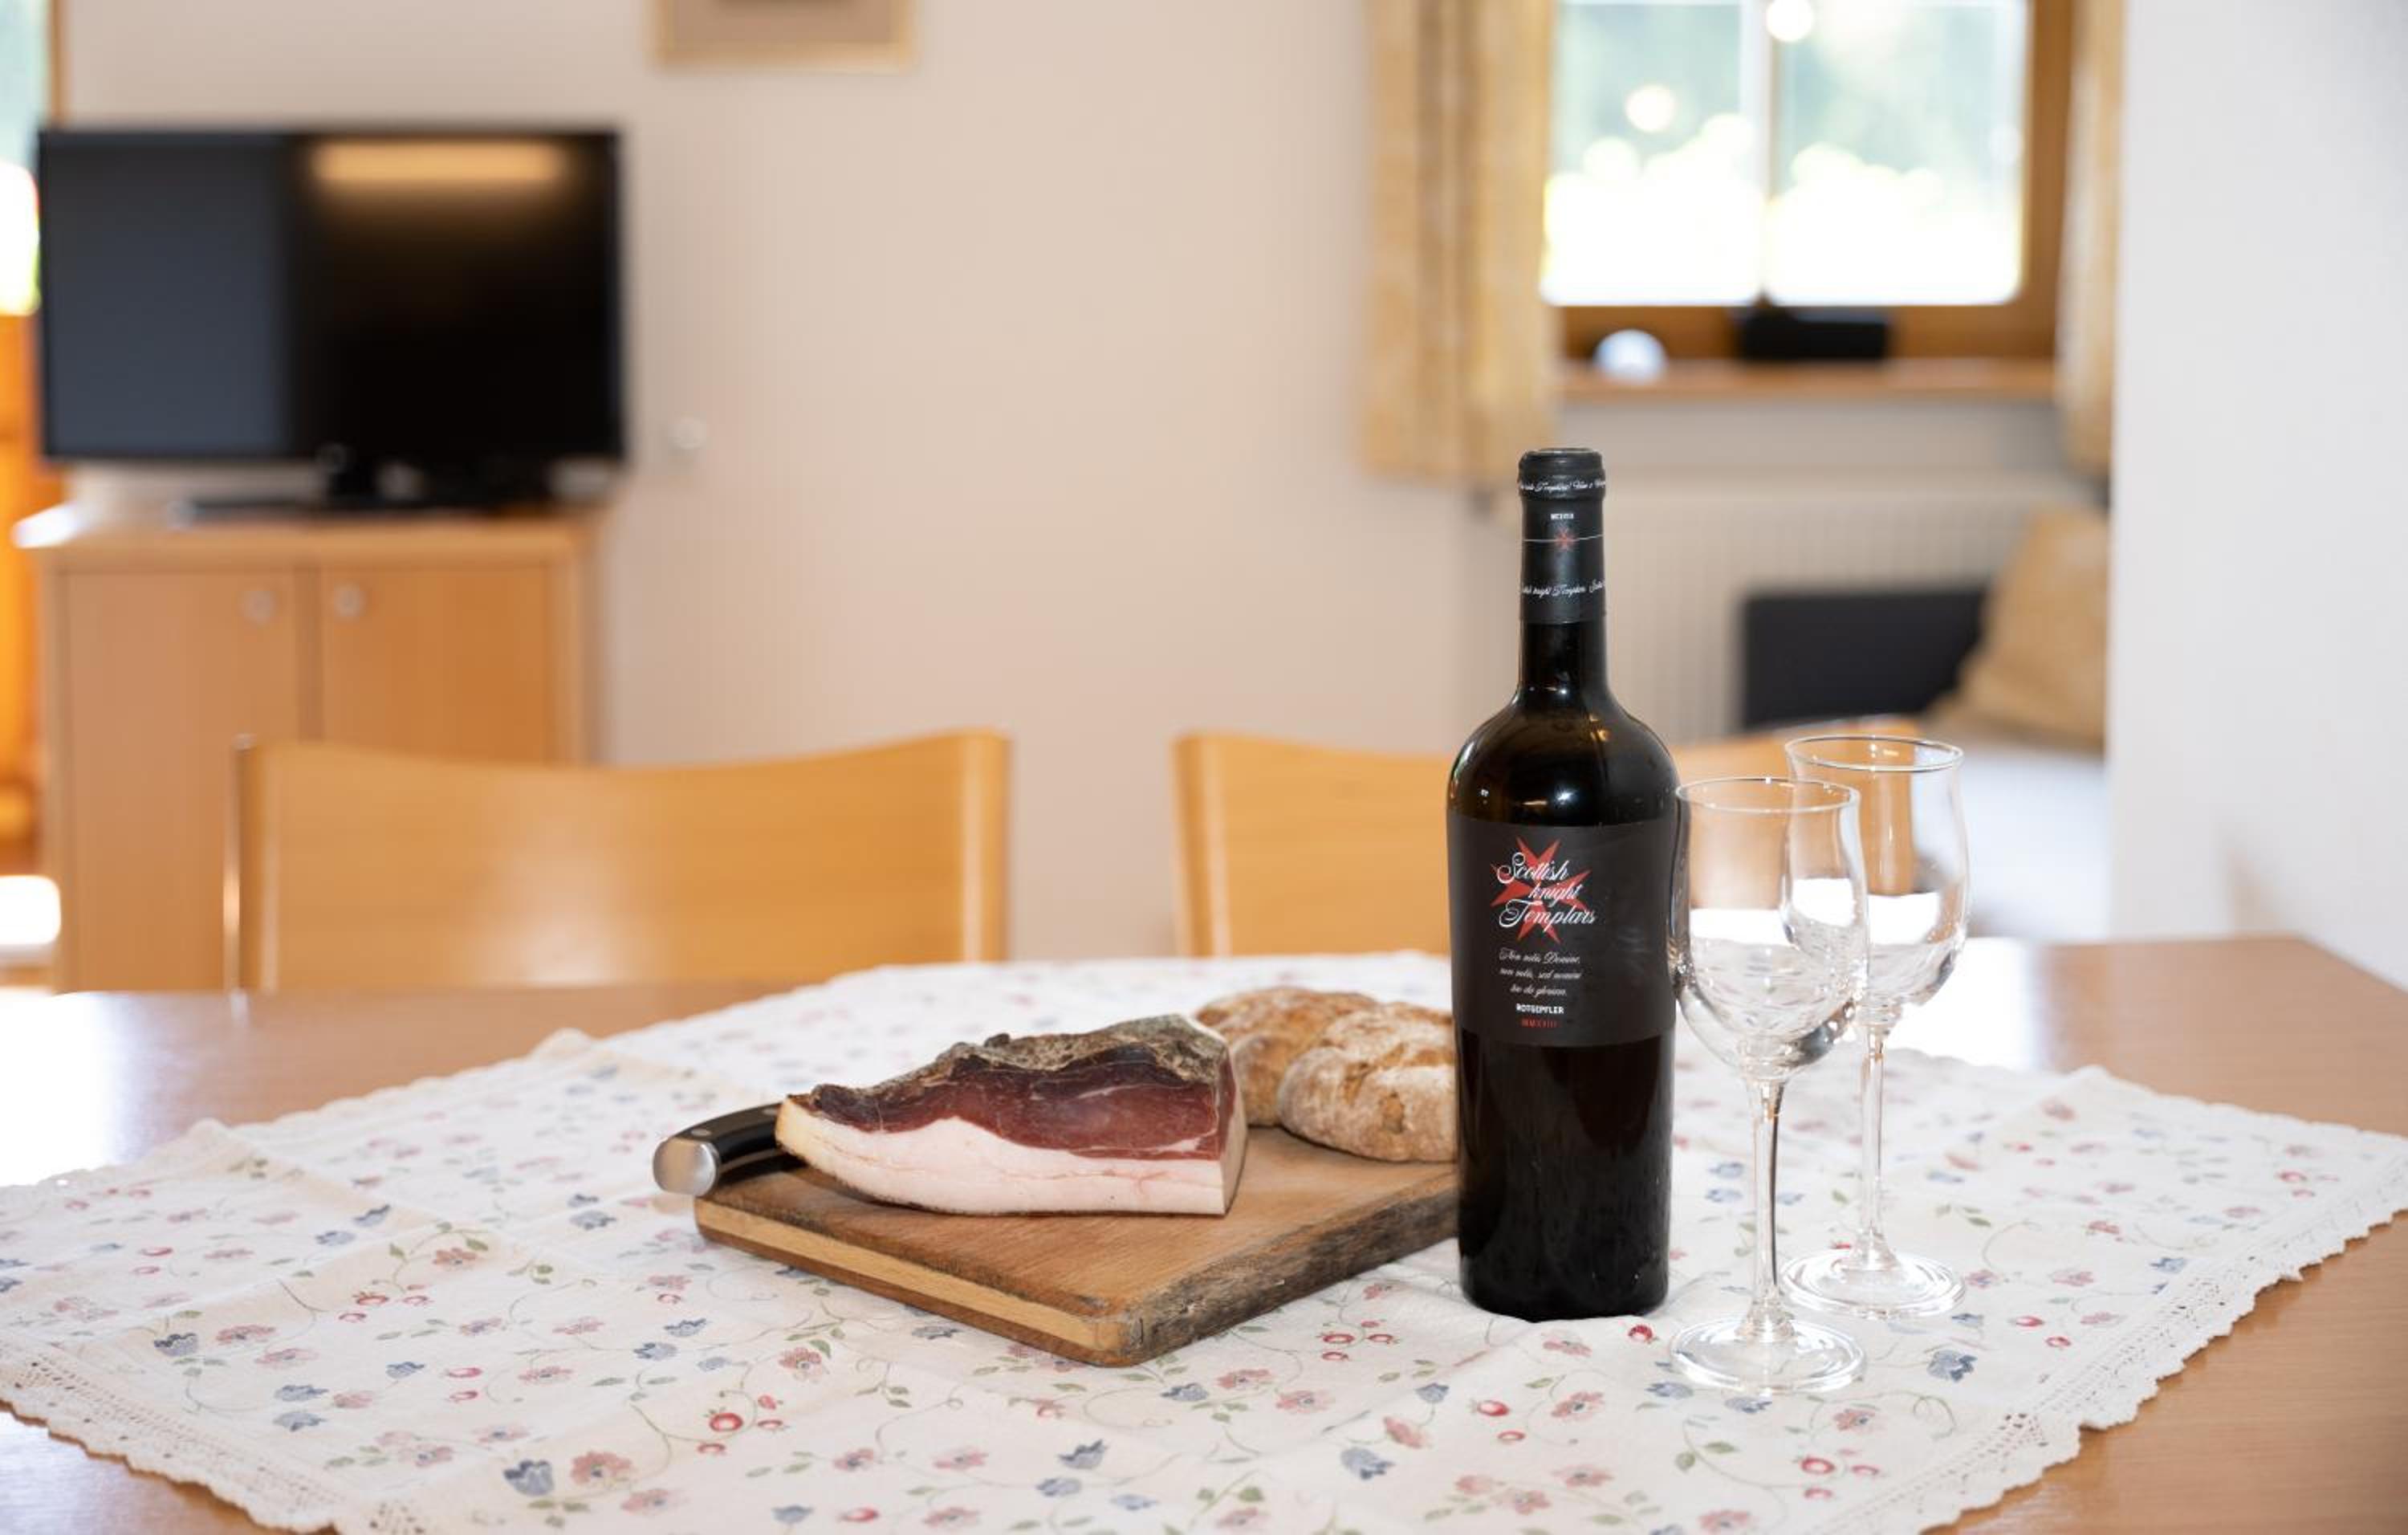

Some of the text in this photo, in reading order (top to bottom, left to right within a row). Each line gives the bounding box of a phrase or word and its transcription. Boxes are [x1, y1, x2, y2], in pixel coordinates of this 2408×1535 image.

[1497, 851, 1571, 884] Scottish
[1527, 882, 1584, 908] knight
[1499, 898, 1597, 933] Templars
